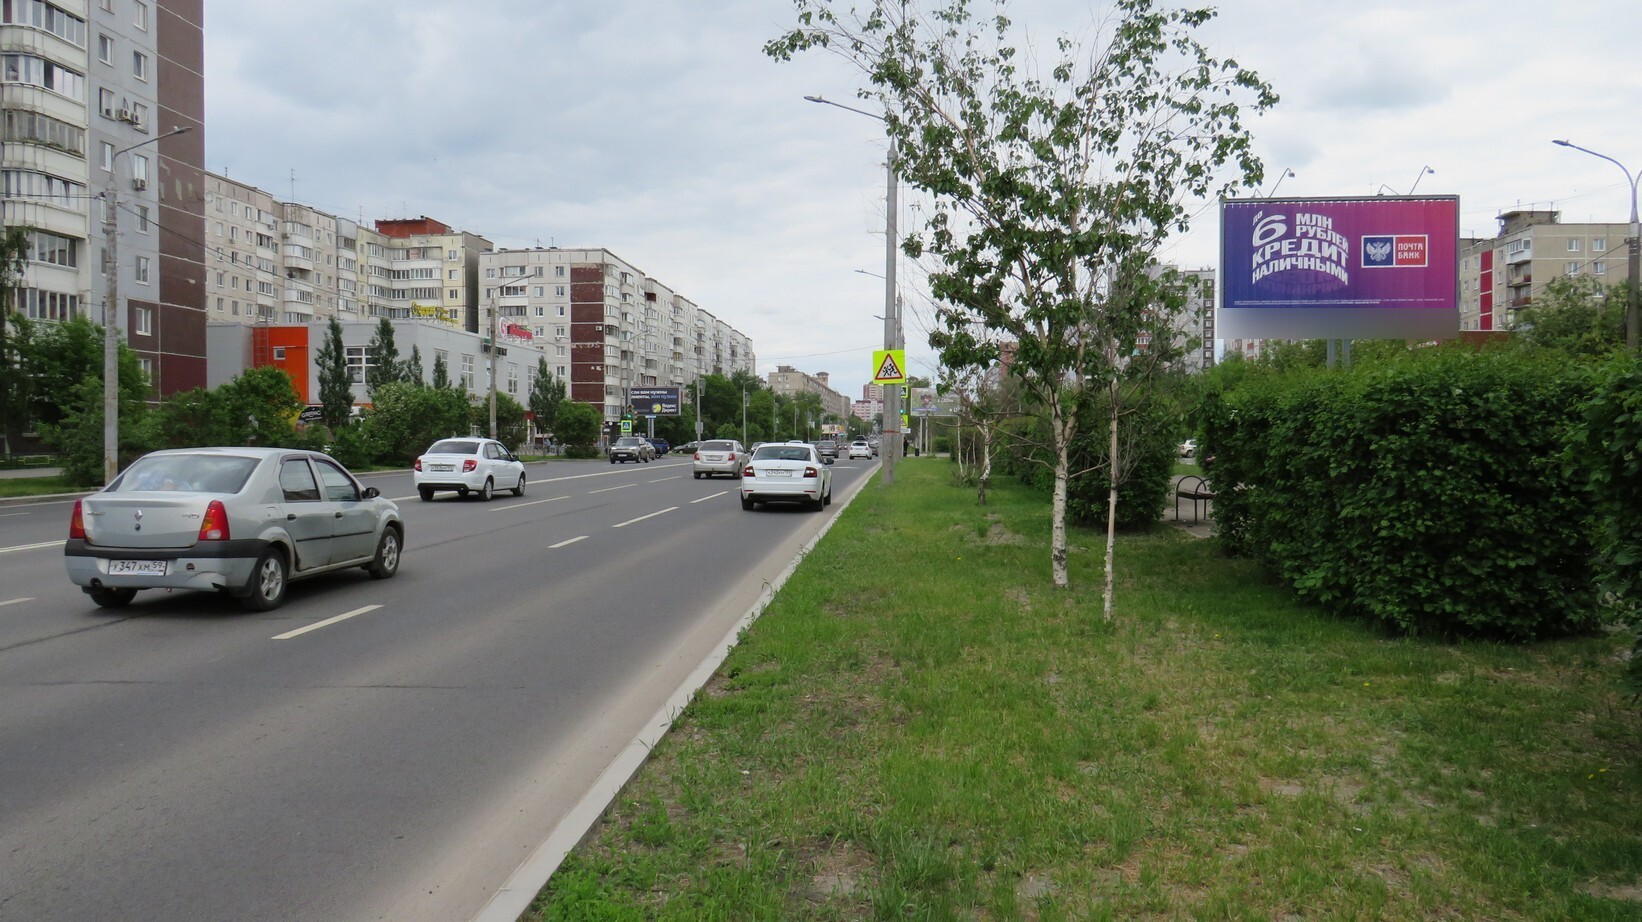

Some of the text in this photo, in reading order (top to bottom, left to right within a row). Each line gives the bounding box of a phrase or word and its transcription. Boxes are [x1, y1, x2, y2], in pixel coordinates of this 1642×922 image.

[1252, 214, 1287, 247] 6
[1295, 213, 1332, 230] МЛН
[1252, 238, 1349, 270] КРЕДИТ
[1295, 225, 1349, 254] РУБЛЕЙ
[1397, 242, 1423, 251] ПОЧТА
[1397, 251, 1420, 260] БАНК
[1252, 257, 1349, 286] НАЛИЧНЫМИ
